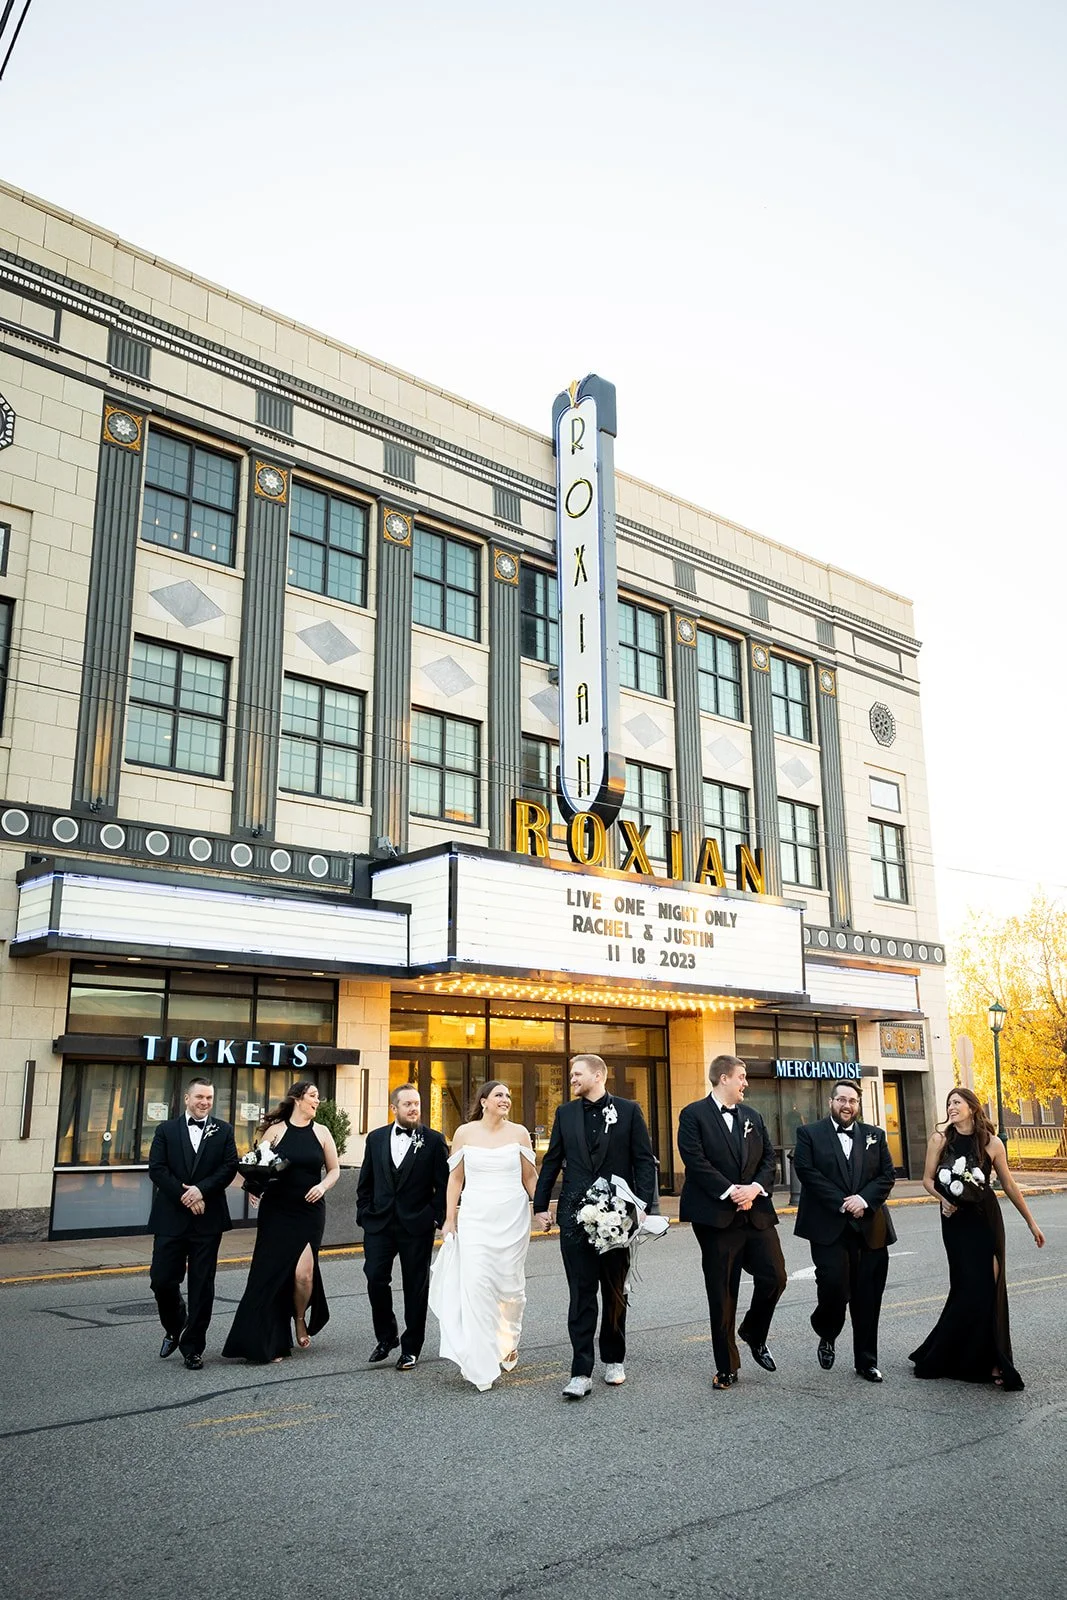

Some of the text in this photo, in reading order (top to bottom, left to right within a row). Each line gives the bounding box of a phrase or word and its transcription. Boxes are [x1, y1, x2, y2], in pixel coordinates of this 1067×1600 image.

[565, 416, 593, 798] ROXIAN
[511, 798, 766, 895] ROXIAN
[566, 888, 738, 928] LIVE ONE NIGHT ONLY
[572, 914, 714, 948] RACHEL & JUSTIN
[607, 944, 696, 969] 11 18 2023
[142, 1035, 309, 1067] TICKETS
[776, 1059, 863, 1079] MERCHANDISE
